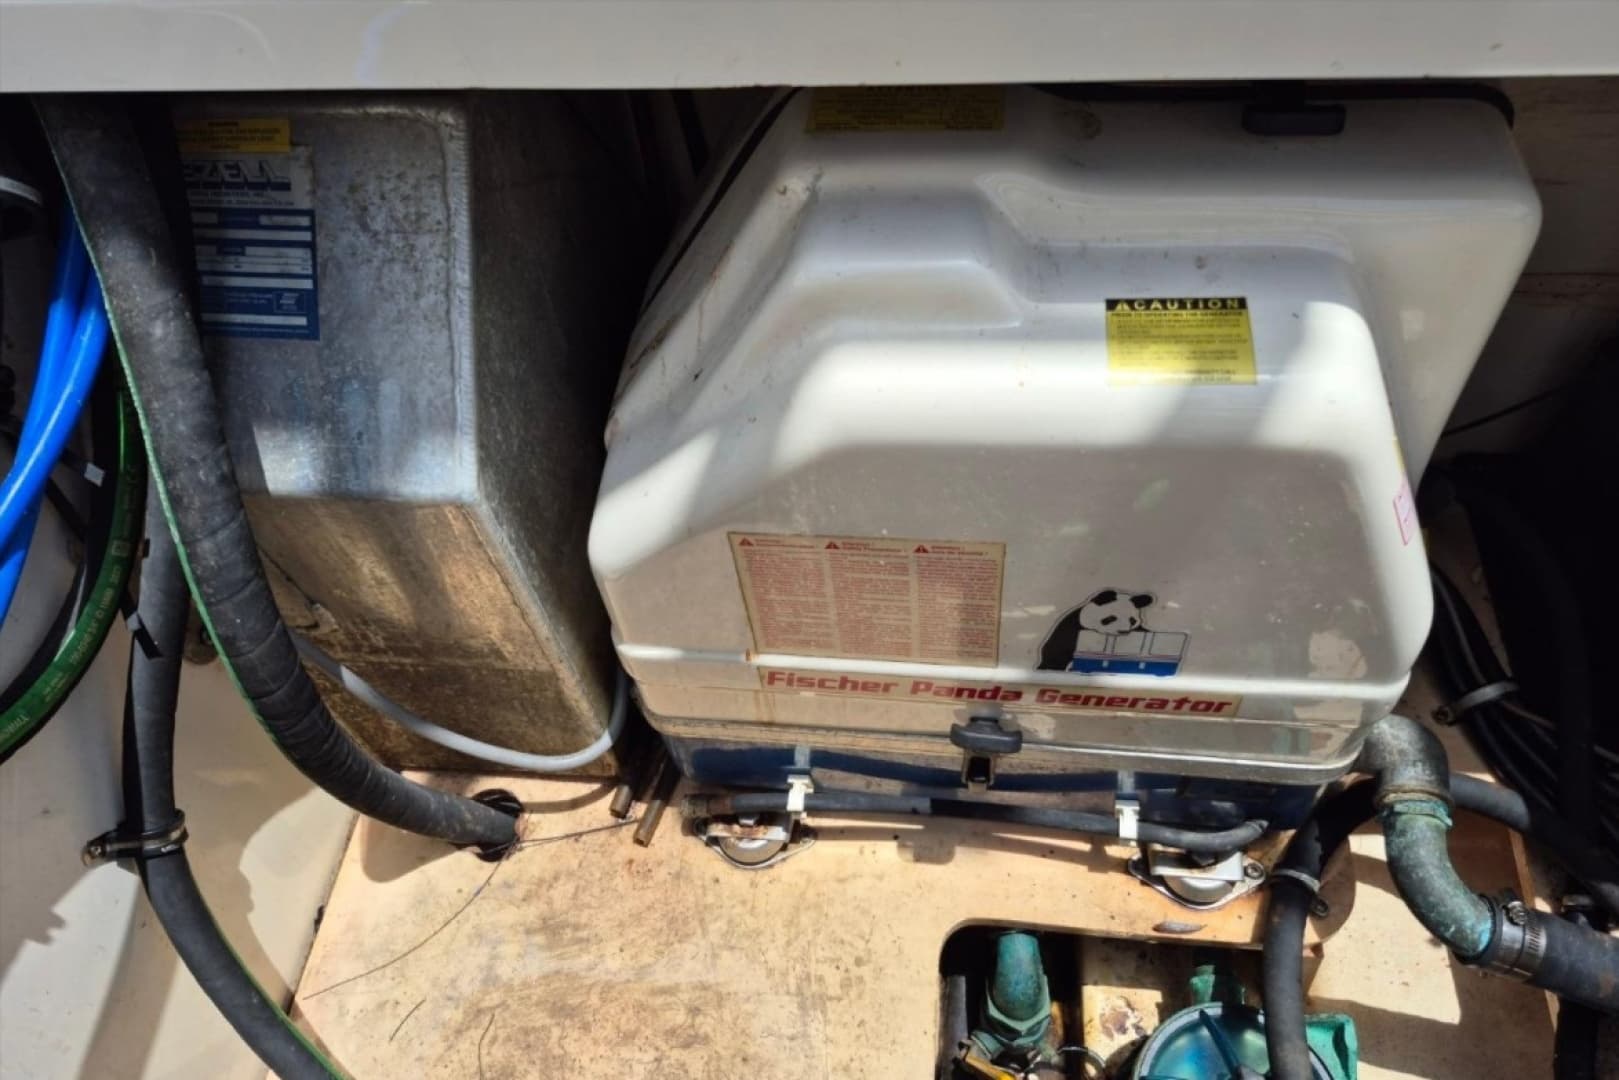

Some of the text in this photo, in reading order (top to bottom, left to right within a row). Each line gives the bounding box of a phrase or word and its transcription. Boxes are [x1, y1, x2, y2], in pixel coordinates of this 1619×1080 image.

[1135, 299, 1239, 310] CAUTION
[766, 670, 1234, 714] Fischer Panda Generator
